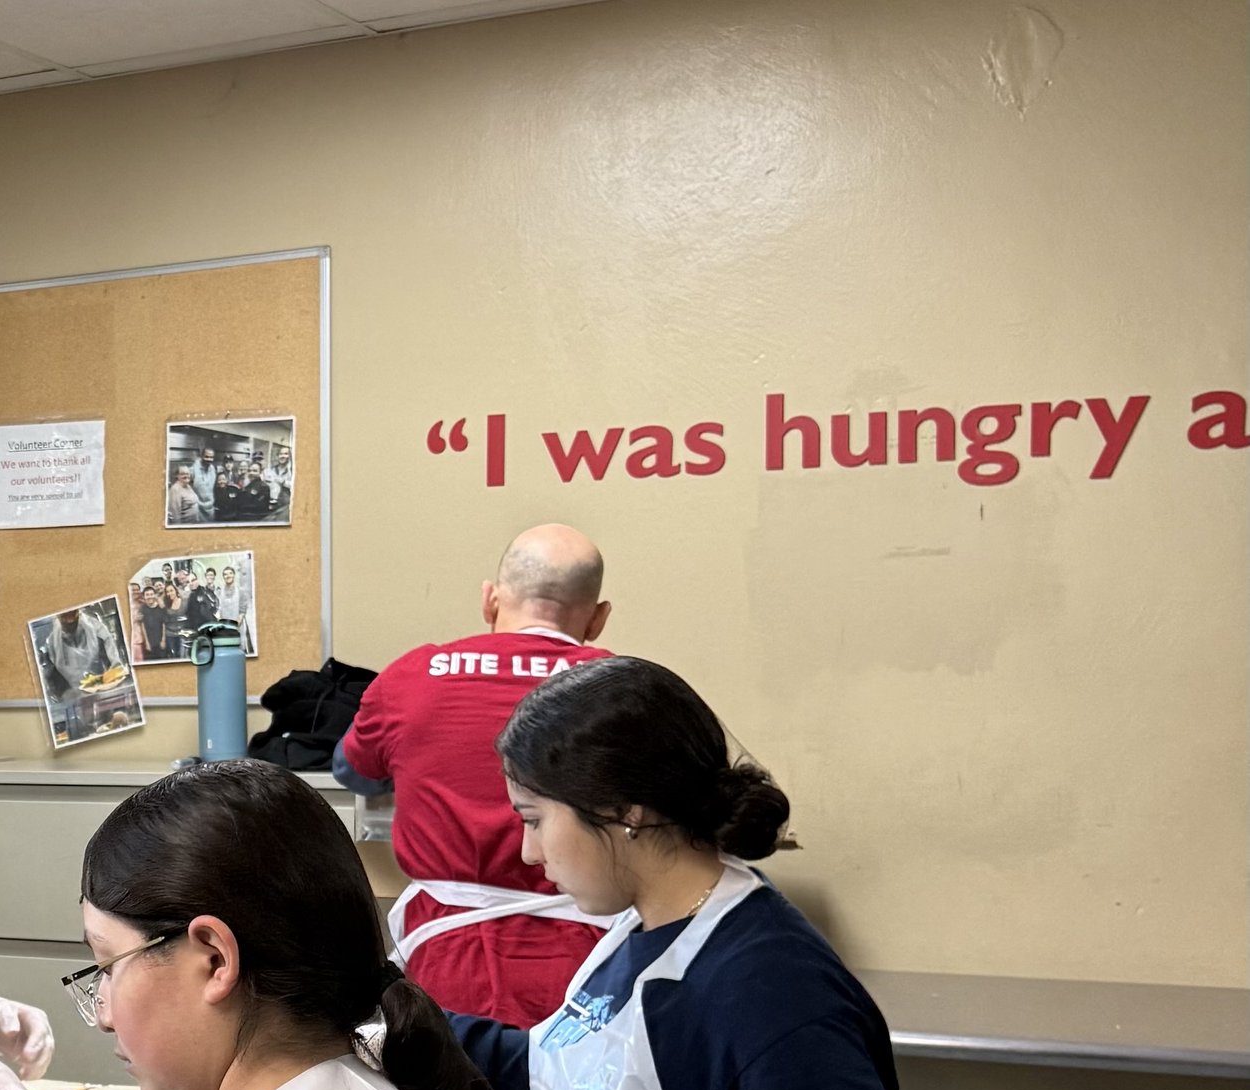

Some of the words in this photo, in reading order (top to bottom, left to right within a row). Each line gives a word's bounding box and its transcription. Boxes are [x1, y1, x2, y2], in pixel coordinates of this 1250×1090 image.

[8, 440, 52, 451] Volunteer
[53, 438, 84, 449] Corner
[541, 421, 726, 483] was
[765, 393, 1151, 487] hungry
[0, 460, 16, 469] We
[18, 460, 40, 469] want
[42, 459, 51, 467] to
[53, 456, 79, 466] thank
[80, 455, 91, 466] all
[10, 478, 25, 486] our
[428, 652, 499, 677] SITE
[512, 655, 592, 678] LEA
